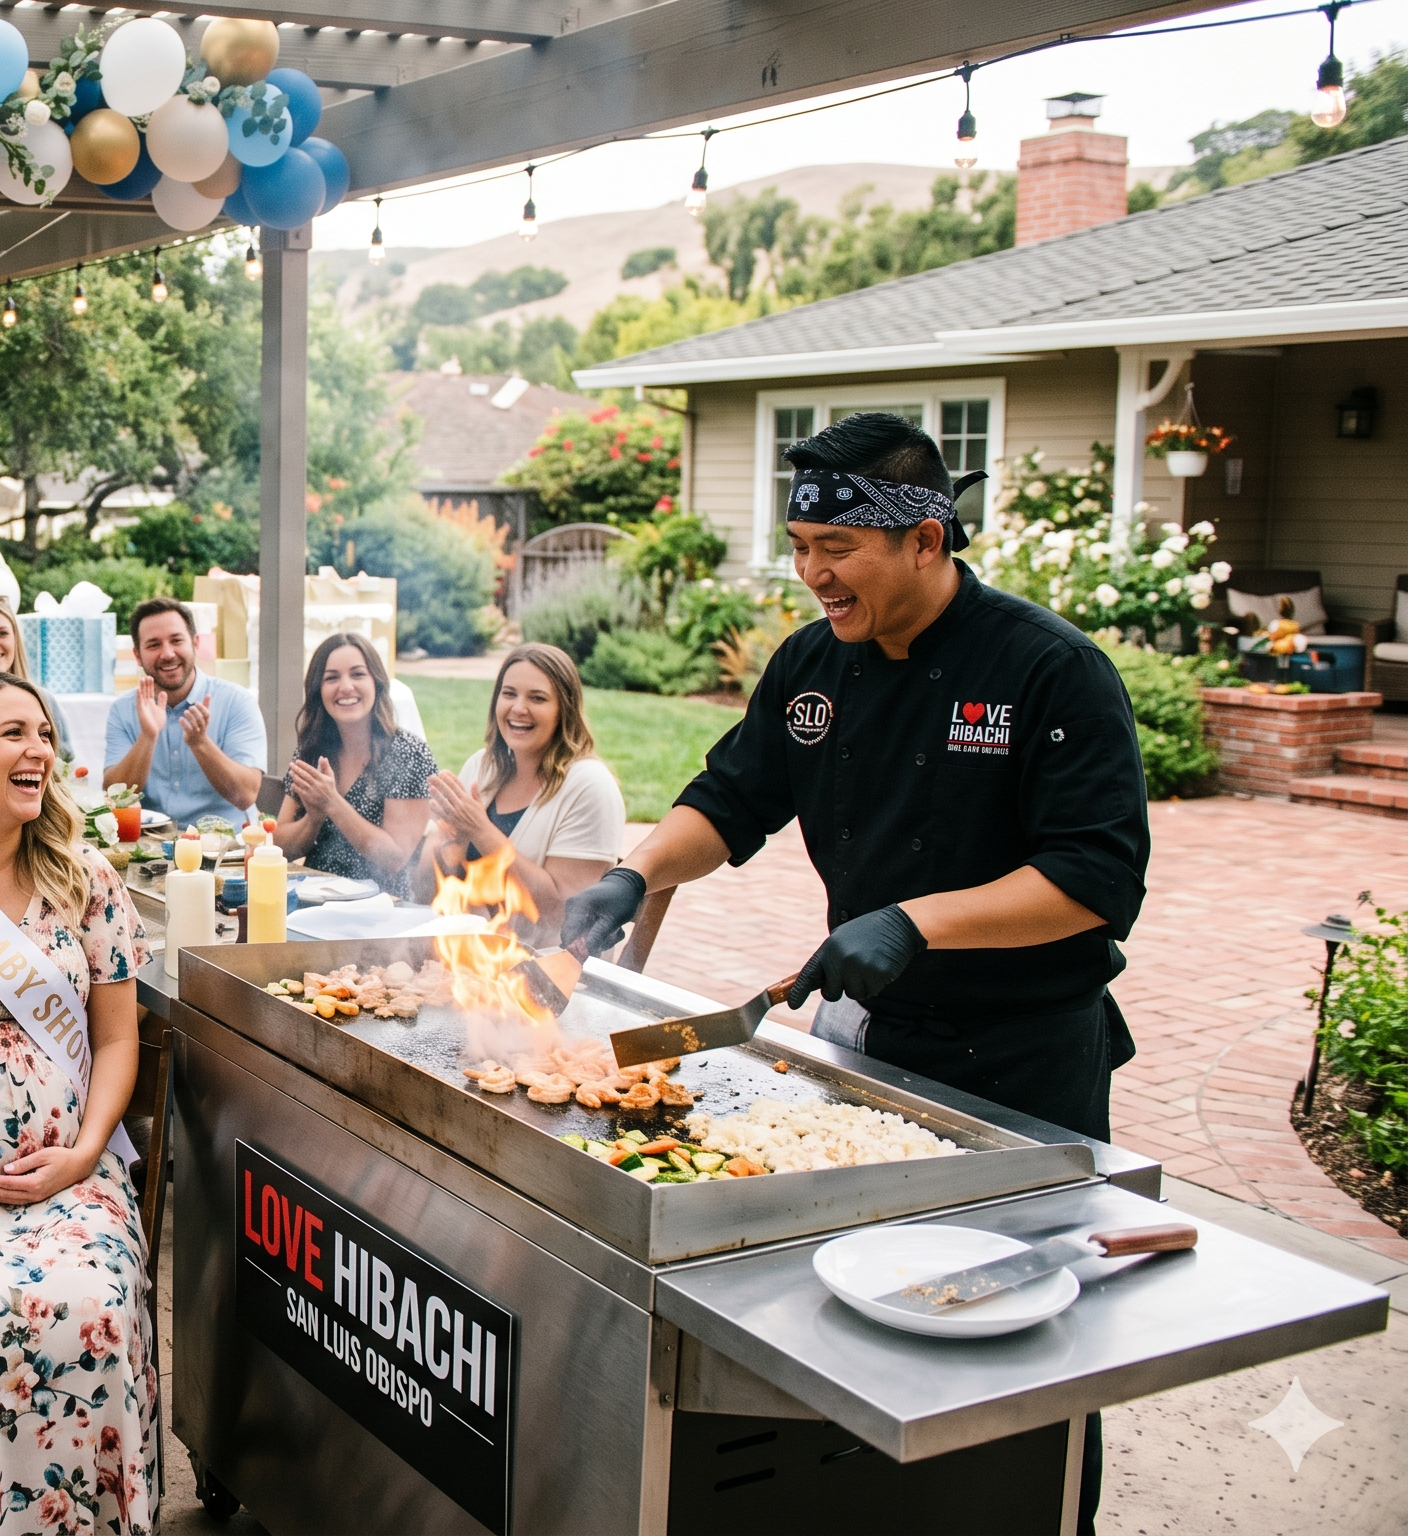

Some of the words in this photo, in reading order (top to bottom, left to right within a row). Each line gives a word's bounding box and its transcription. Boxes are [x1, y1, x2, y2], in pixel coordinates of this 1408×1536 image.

[794, 703, 826, 726] SLO
[949, 724, 1010, 744] HIBACHI
[244, 1169, 324, 1292] LOVE
[334, 1231, 496, 1417] HIBACHI
[286, 1286, 319, 1342] SAN
[323, 1313, 361, 1374] LUIS
[365, 1347, 433, 1428] OBISPO
